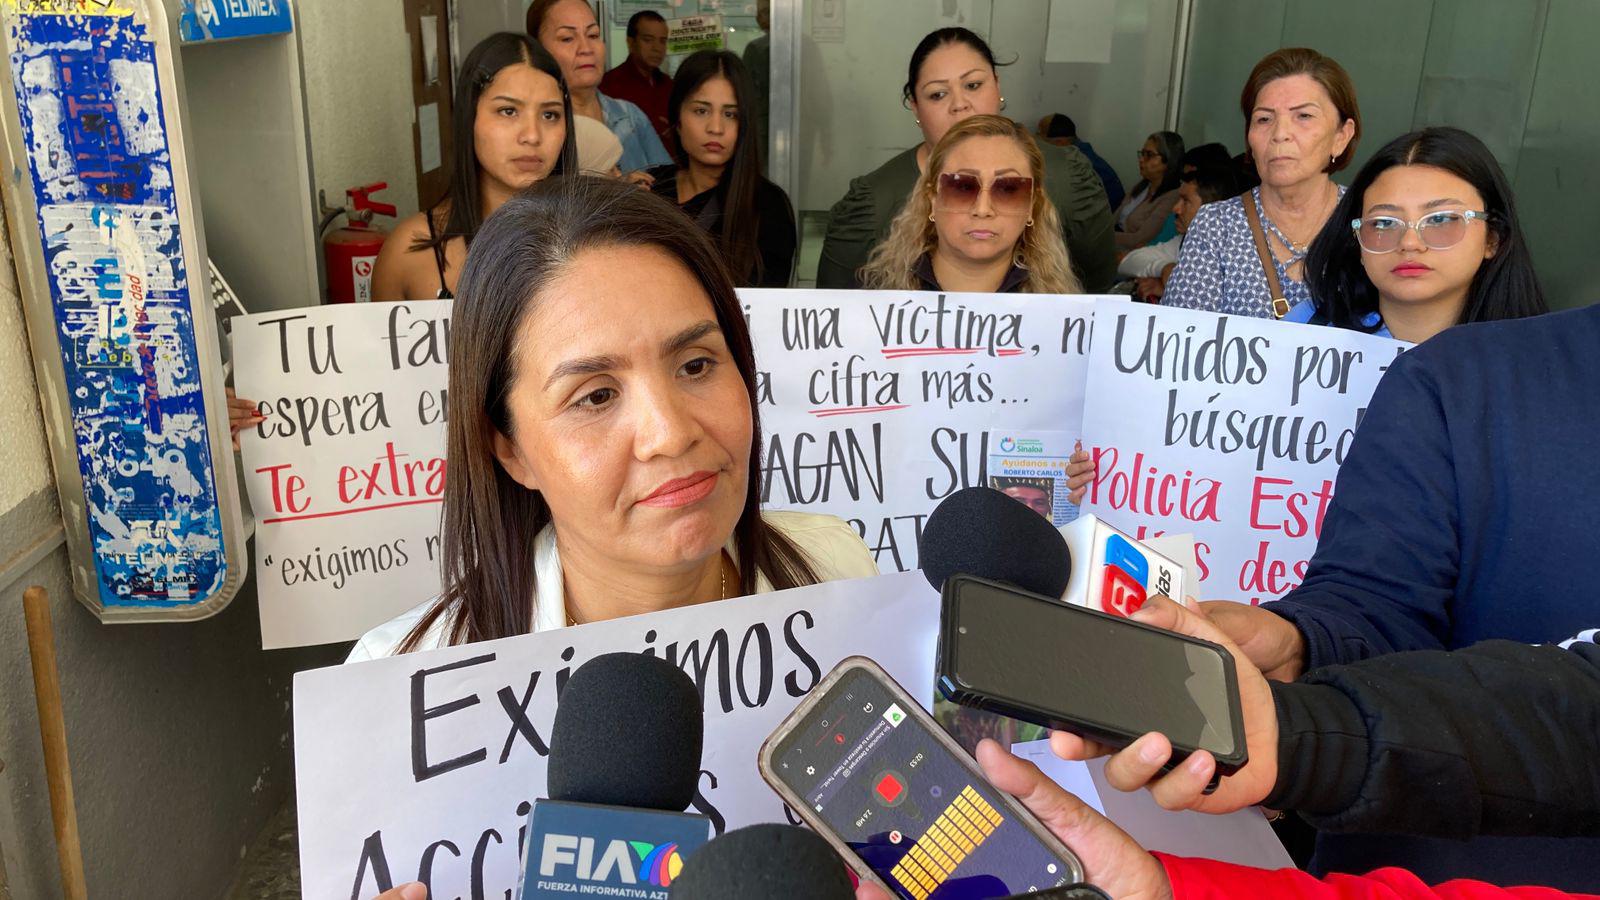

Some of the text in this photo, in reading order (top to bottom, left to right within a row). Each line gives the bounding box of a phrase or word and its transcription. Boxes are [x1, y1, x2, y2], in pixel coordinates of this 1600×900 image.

[258, 315, 343, 375] Tu
[782, 306, 844, 351] una
[808, 354, 902, 407] cifra
[1114, 314, 1364, 407] Unidos por
[256, 391, 392, 447] espera
[1017, 445, 1043, 453] Sinaloa
[255, 463, 312, 515] Te
[909, 753, 923, 768] 02:53
[539, 833, 638, 885] FIA
[537, 881, 578, 893] FUERZA
[580, 885, 648, 900] INFORMATIVA
